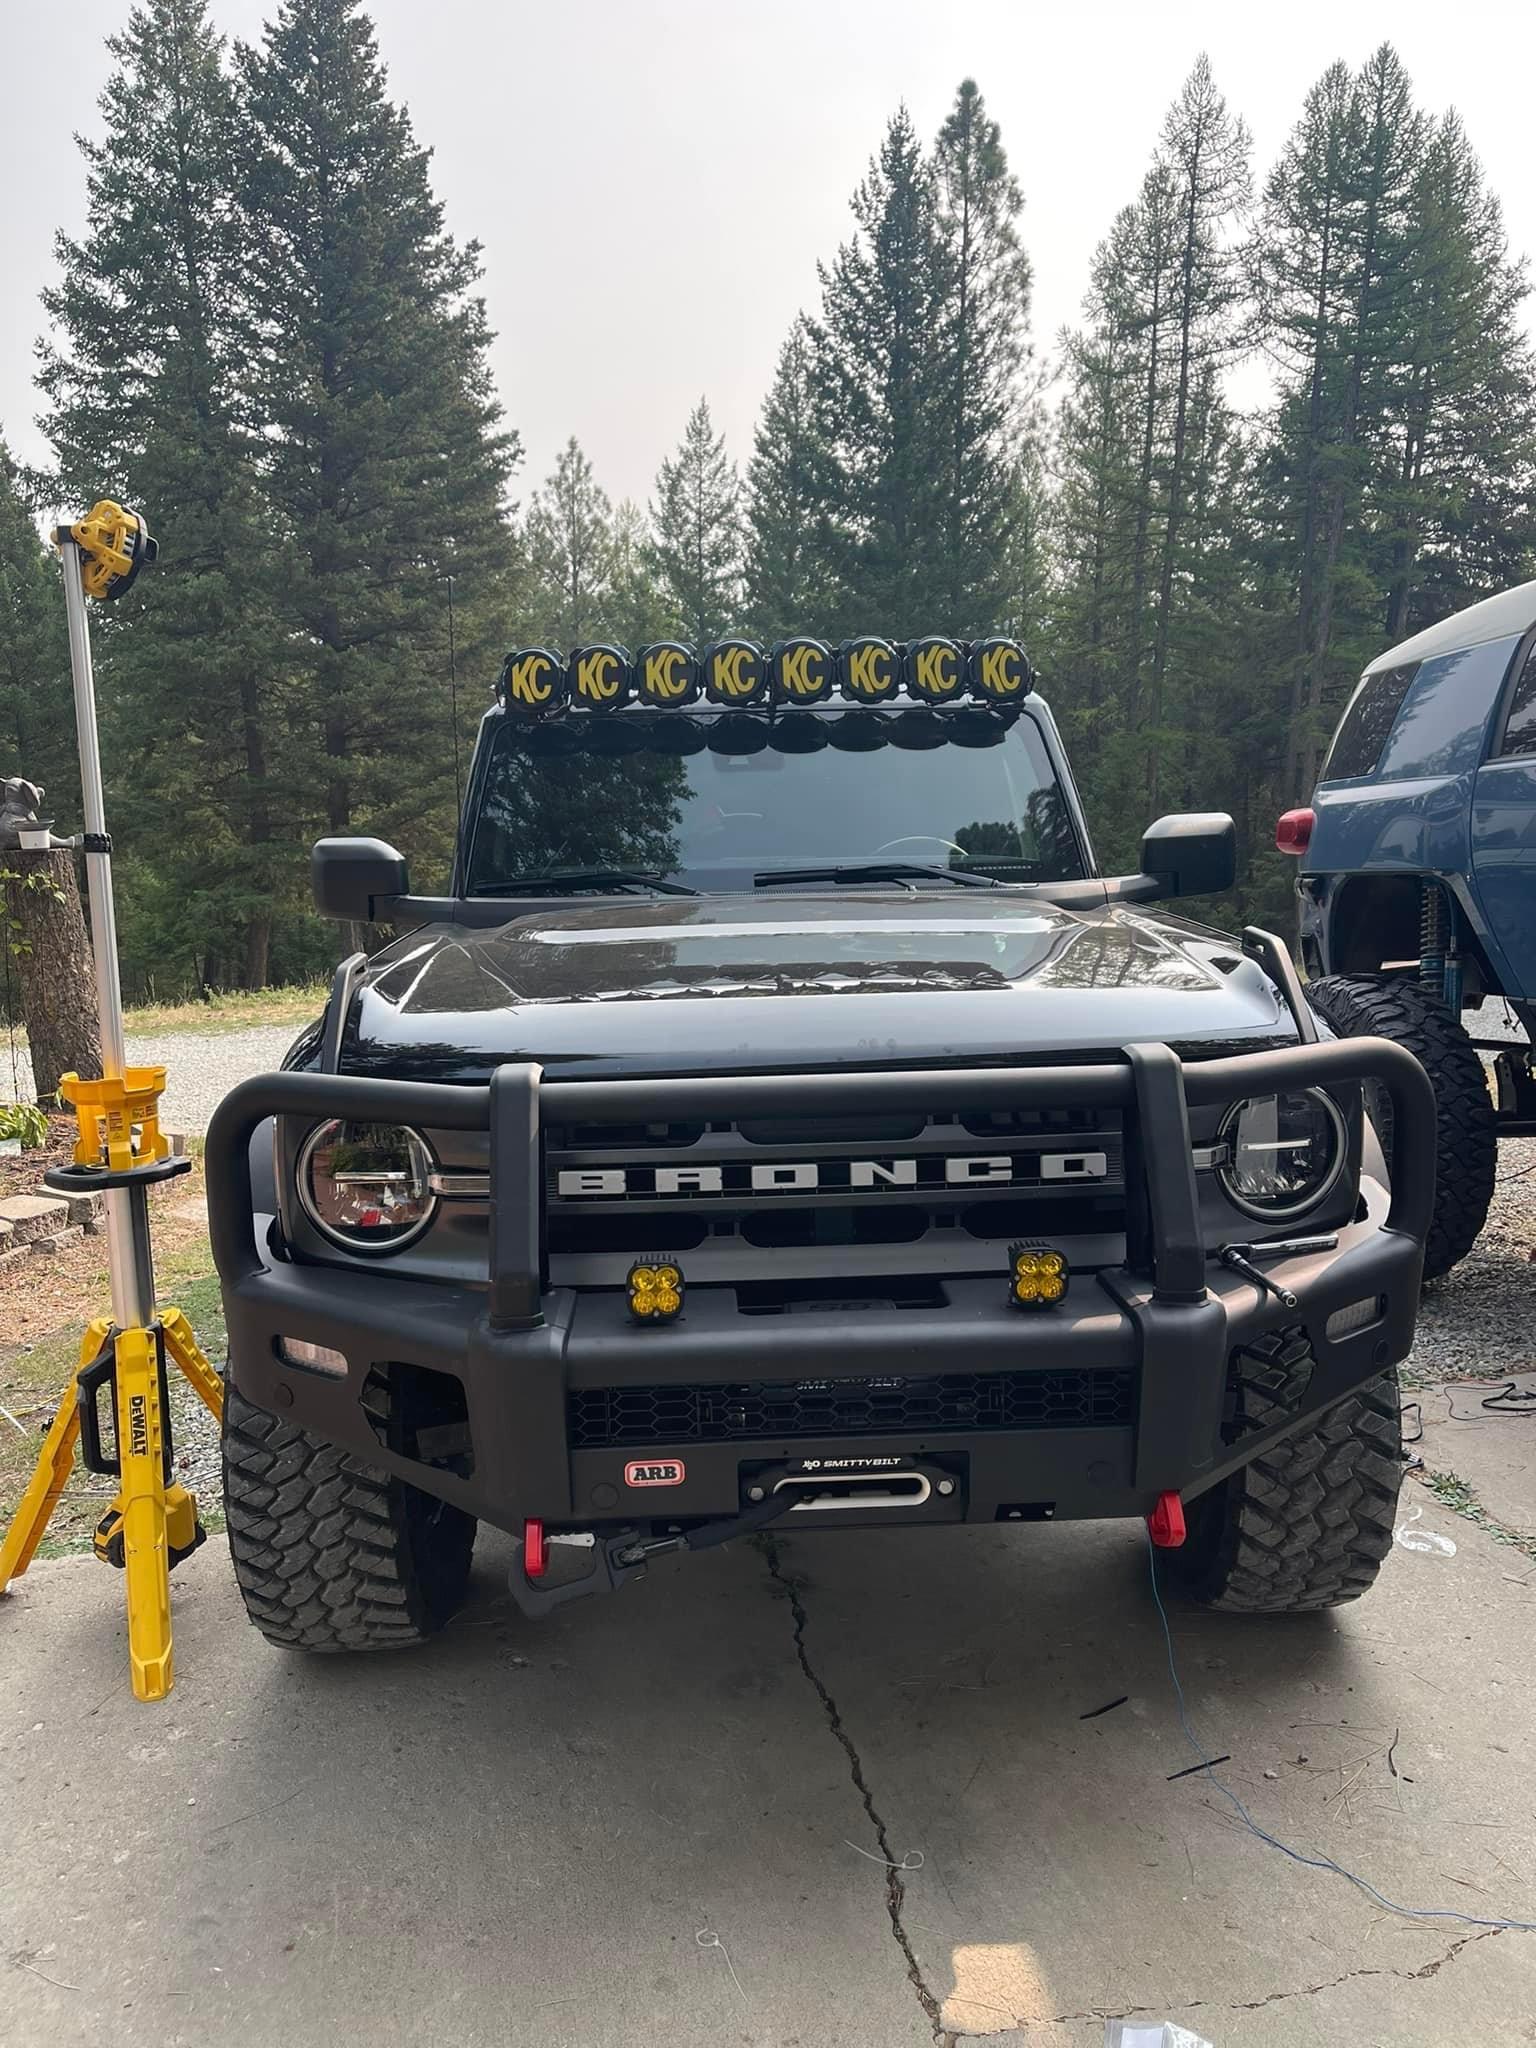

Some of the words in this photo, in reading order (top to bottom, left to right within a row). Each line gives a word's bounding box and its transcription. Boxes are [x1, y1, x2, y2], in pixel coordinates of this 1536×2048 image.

[511, 655, 552, 704] KC
[577, 652, 619, 700] KC
[646, 649, 688, 698] KC
[713, 647, 756, 696] KC
[782, 645, 824, 694] KC
[850, 645, 891, 694] KC
[917, 645, 957, 693] KC
[982, 645, 1021, 694] KC
[557, 1151, 1108, 1196] BRONCO
[632, 1465, 678, 1482] ARB
[823, 1457, 902, 1468] SMITTYBILT
